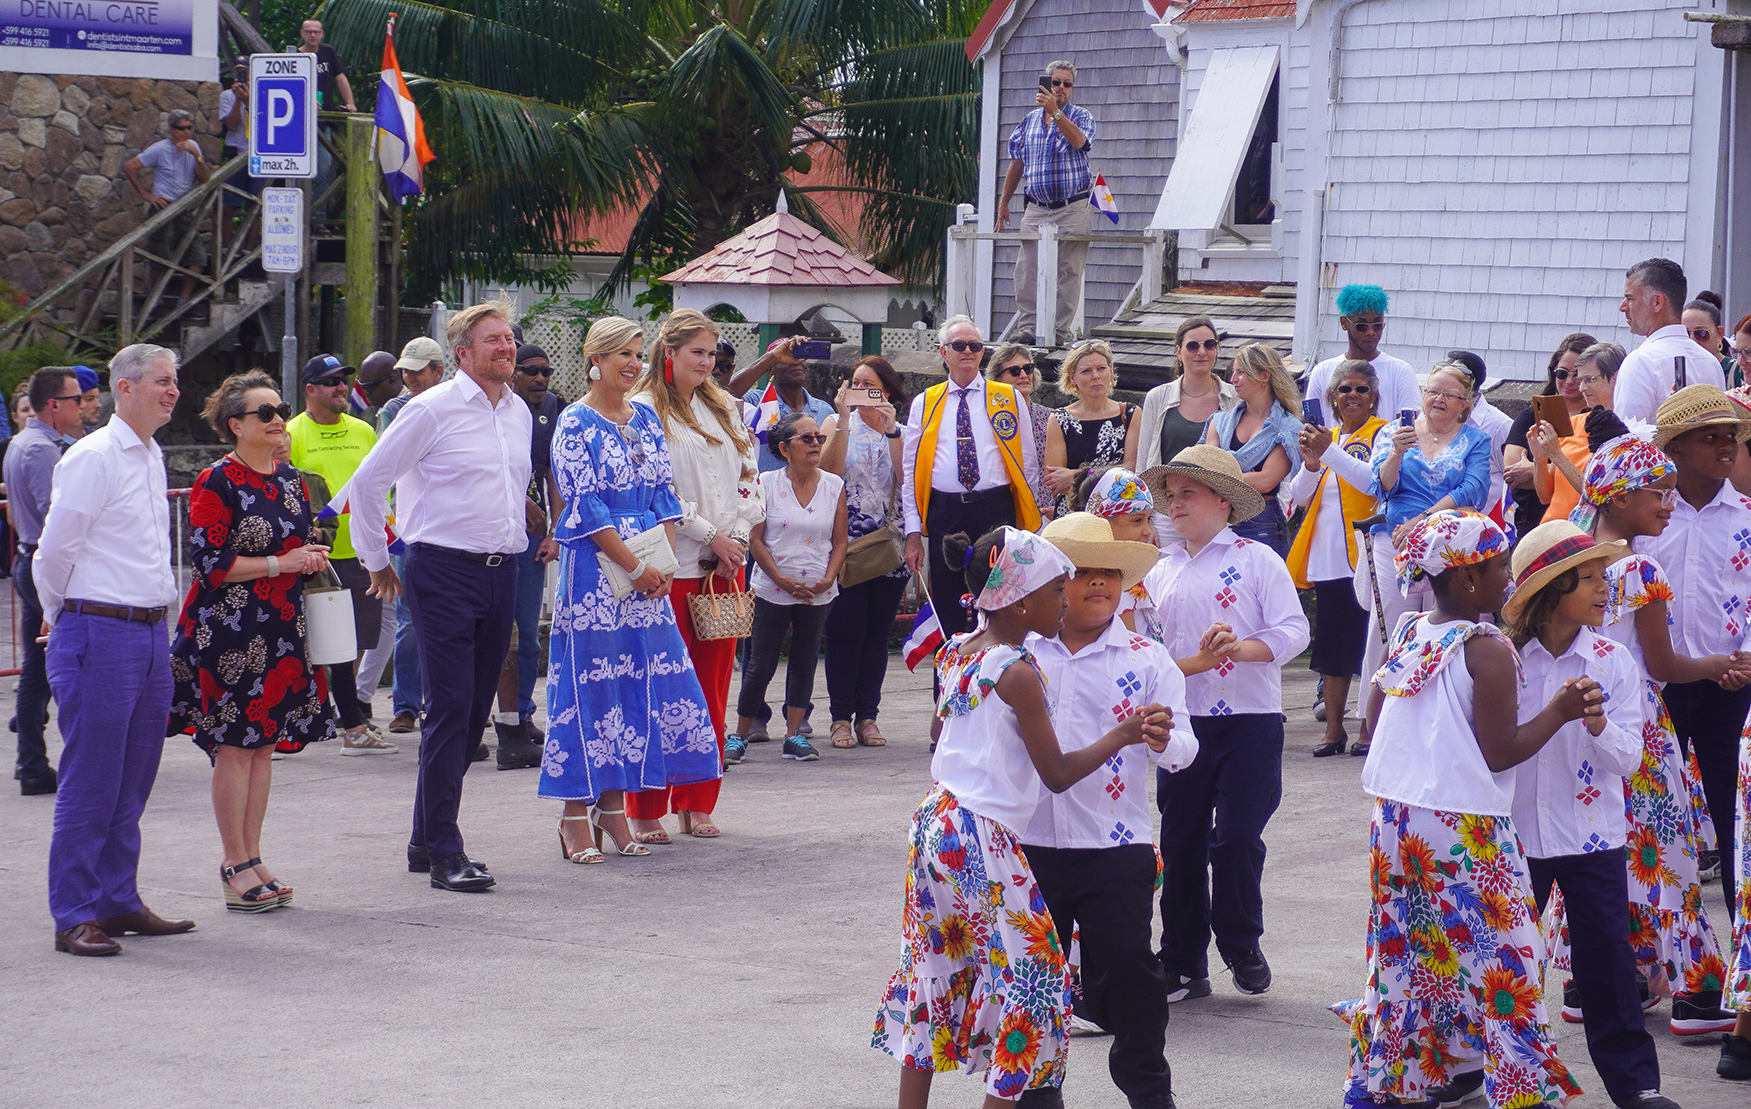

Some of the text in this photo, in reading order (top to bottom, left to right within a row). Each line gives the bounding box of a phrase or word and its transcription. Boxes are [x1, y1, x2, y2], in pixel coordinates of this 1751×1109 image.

[21, 0, 159, 25] DENTAL CARE
[20, 27, 32, 36] 416
[33, 28, 50, 37] 5921
[20, 38, 32, 47] 416
[33, 39, 50, 48] 5921
[87, 31, 183, 45] dentistsintmaarten.com
[265, 61, 297, 74] ZONE
[267, 88, 294, 145] P
[262, 158, 299, 170] max 2h.
[268, 204, 294, 214] PARKING
[267, 225, 295, 234] ALLOWED
[264, 244, 297, 254] MAX 2 HOUR
[1002, 420, 1009, 429] L
